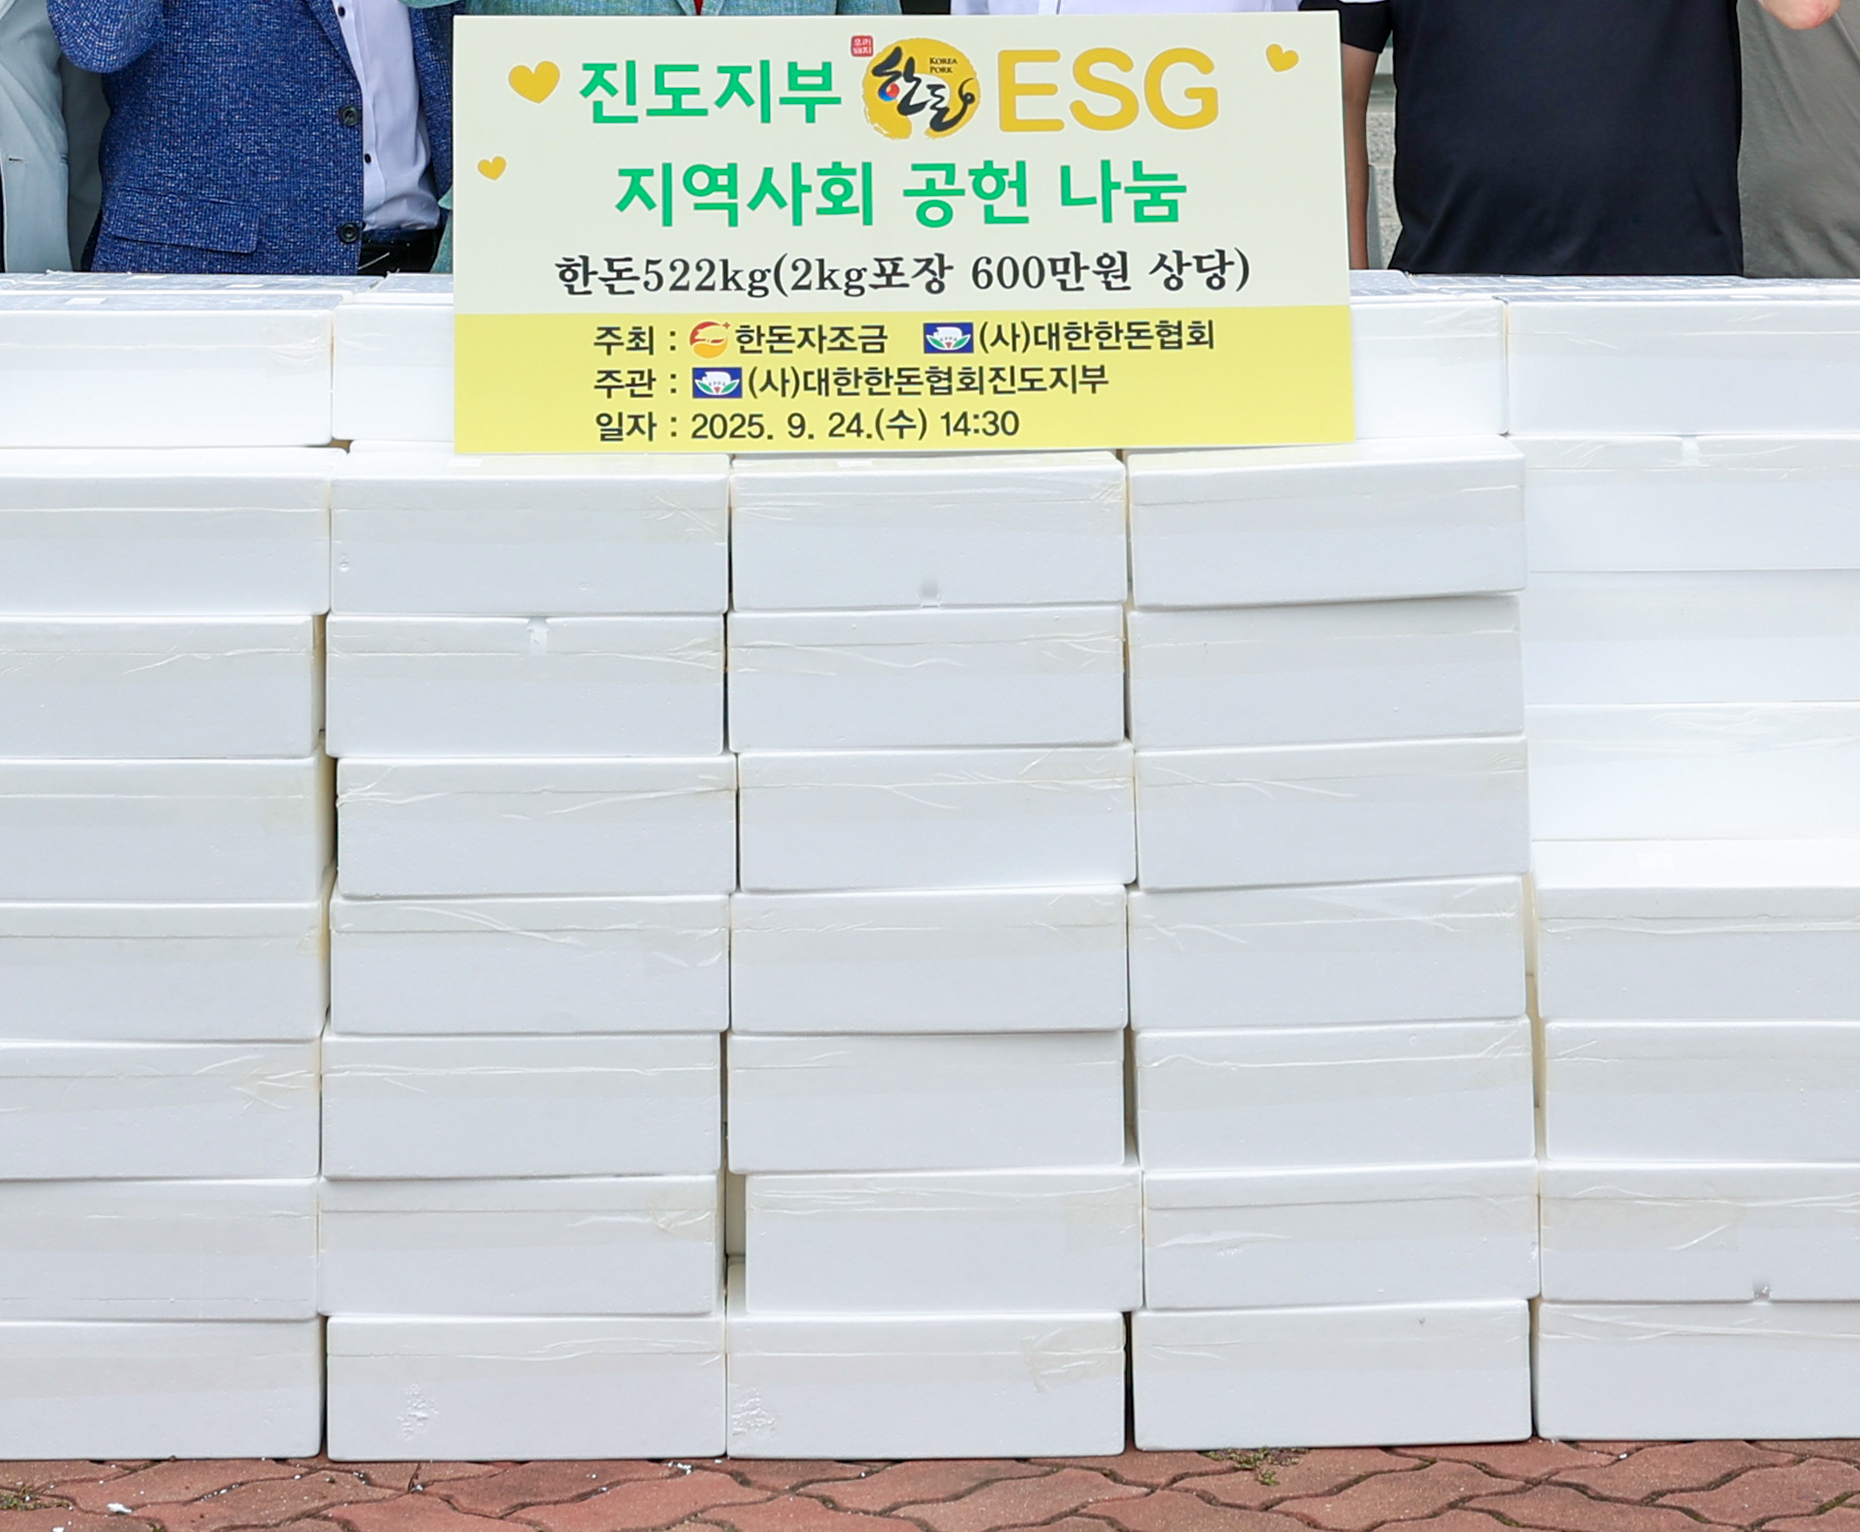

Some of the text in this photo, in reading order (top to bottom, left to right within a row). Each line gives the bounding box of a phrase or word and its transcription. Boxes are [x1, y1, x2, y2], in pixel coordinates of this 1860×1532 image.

[929, 57, 958, 65] KOREA
[929, 66, 953, 74] PORK
[580, 60, 842, 124] 진도지부
[998, 48, 1218, 132] ESG
[616, 159, 1187, 228] 지역사회 공헌 나눔
[555, 248, 1249, 298] 한돈522kg(2kg포장 600만원 상당)
[594, 326, 654, 356] 주최
[735, 325, 888, 354] 한돈자조금
[980, 320, 1213, 353] (사)대한한돈협회
[594, 369, 656, 399] 주관
[749, 365, 1109, 399] (사)대한한돈협회진도지부
[596, 412, 657, 442] 일자
[692, 413, 773, 440] 2025.
[788, 413, 814, 439] 9.
[829, 408, 927, 440] 24.(수)
[941, 410, 1019, 436] 14:30
